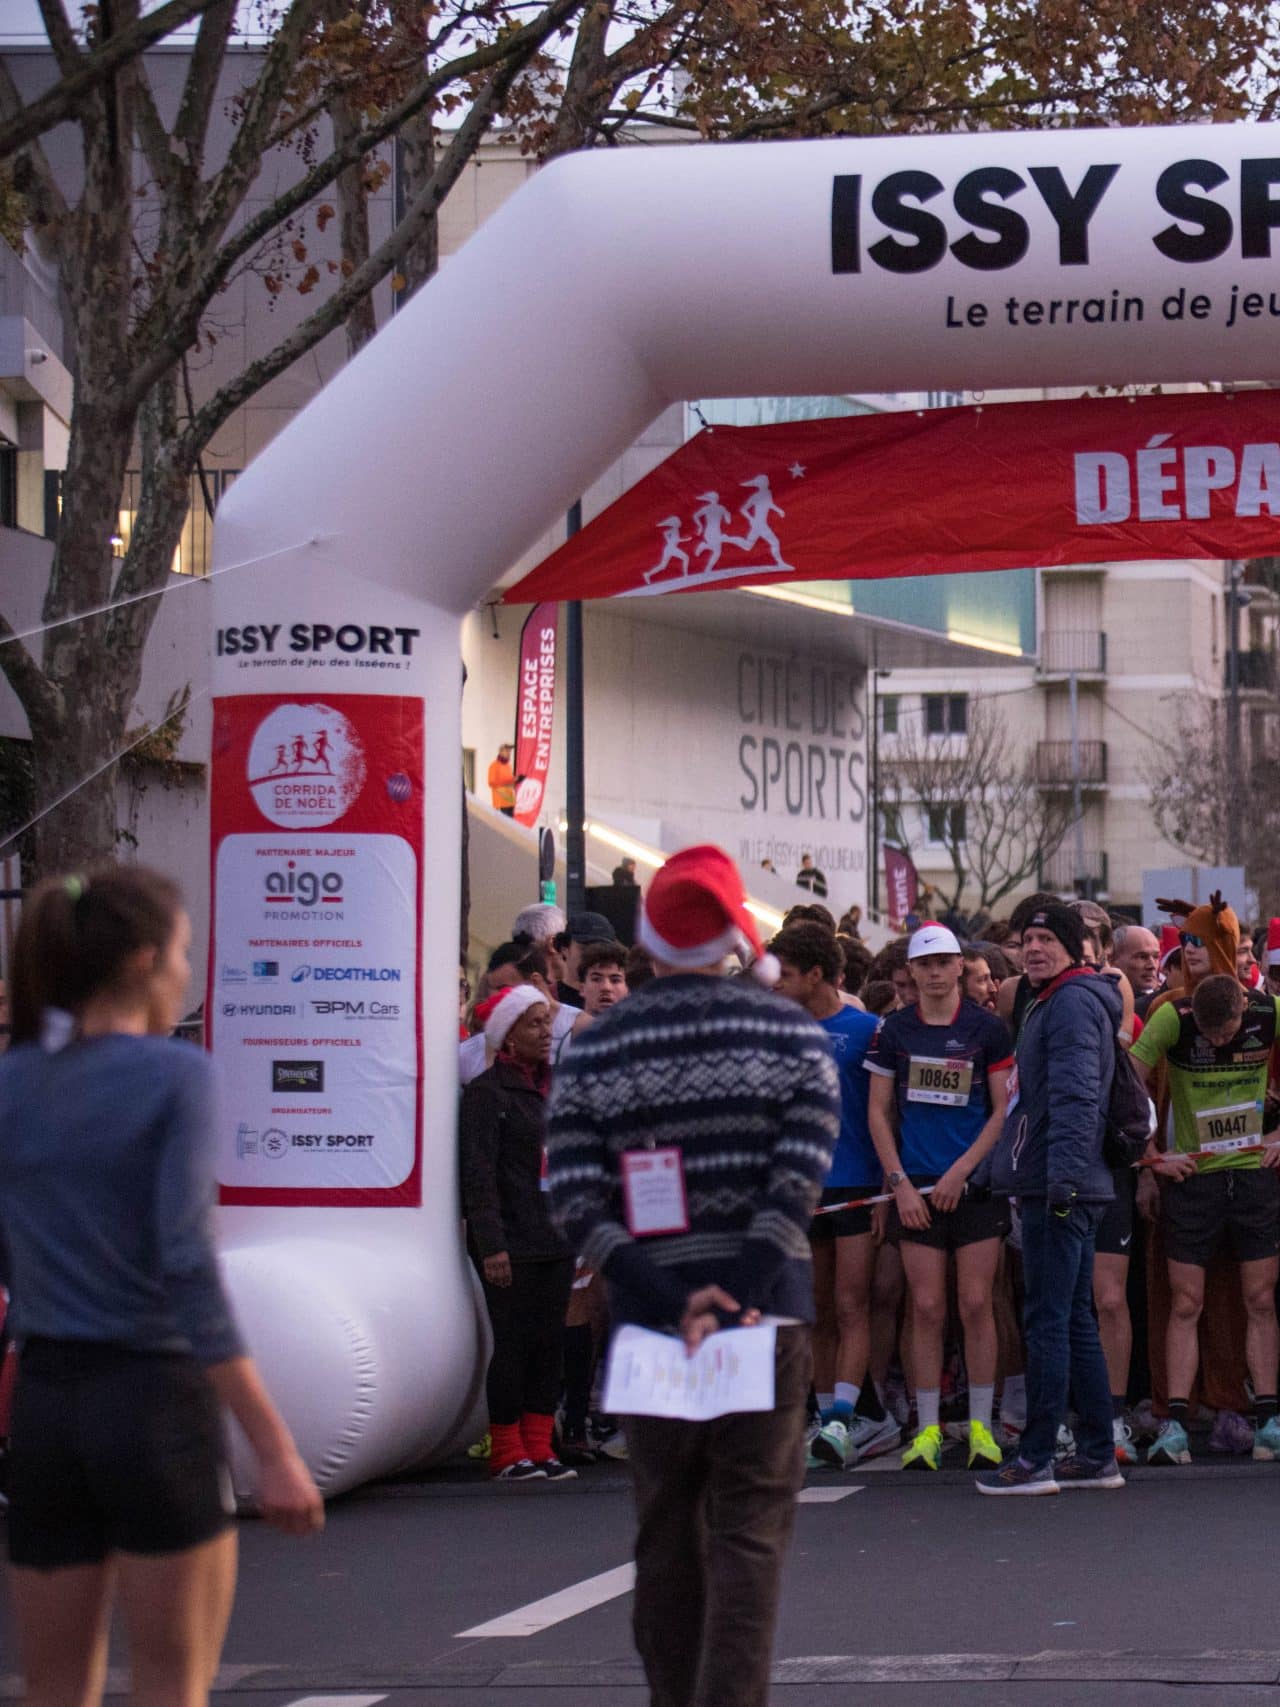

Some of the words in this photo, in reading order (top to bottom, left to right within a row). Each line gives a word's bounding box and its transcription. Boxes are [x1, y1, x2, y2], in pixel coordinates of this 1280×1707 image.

[831, 163, 1121, 275] ISSY
[945, 295, 989, 329] Le
[1005, 287, 1145, 327] terrain
[1161, 287, 1211, 321] de
[217, 624, 282, 657] ISSY
[290, 623, 421, 657] SPORT
[252, 658, 288, 668] terrain
[290, 657, 304, 667] de
[328, 657, 351, 667] des
[522, 657, 538, 739] ESPACE
[535, 627, 555, 772] ENTREPRISES
[810, 664, 865, 742] DES
[739, 734, 866, 823] SPORTS
[274, 784, 337, 796] CORRIDA
[275, 798, 292, 809] DE
[297, 795, 337, 809] NOËL
[256, 848, 313, 857] PARTENAIRE
[315, 848, 357, 857] MAJEUR
[265, 860, 344, 907] aigo
[264, 911, 345, 921] PROMOTION
[248, 939, 310, 948] PARTENAIRES
[313, 939, 363, 948] OFFICIELS
[314, 967, 400, 982] DECATHLON
[240, 1004, 297, 1016] HYUNDAI
[310, 1000, 365, 1014] BPM
[369, 1001, 400, 1015] Cars
[312, 1038, 362, 1047] OFFICIELS
[920, 1067, 960, 1090] 10863
[1207, 1114, 1248, 1139] 10447
[291, 1135, 323, 1147] ISSY
[327, 1135, 375, 1147] SPORT
